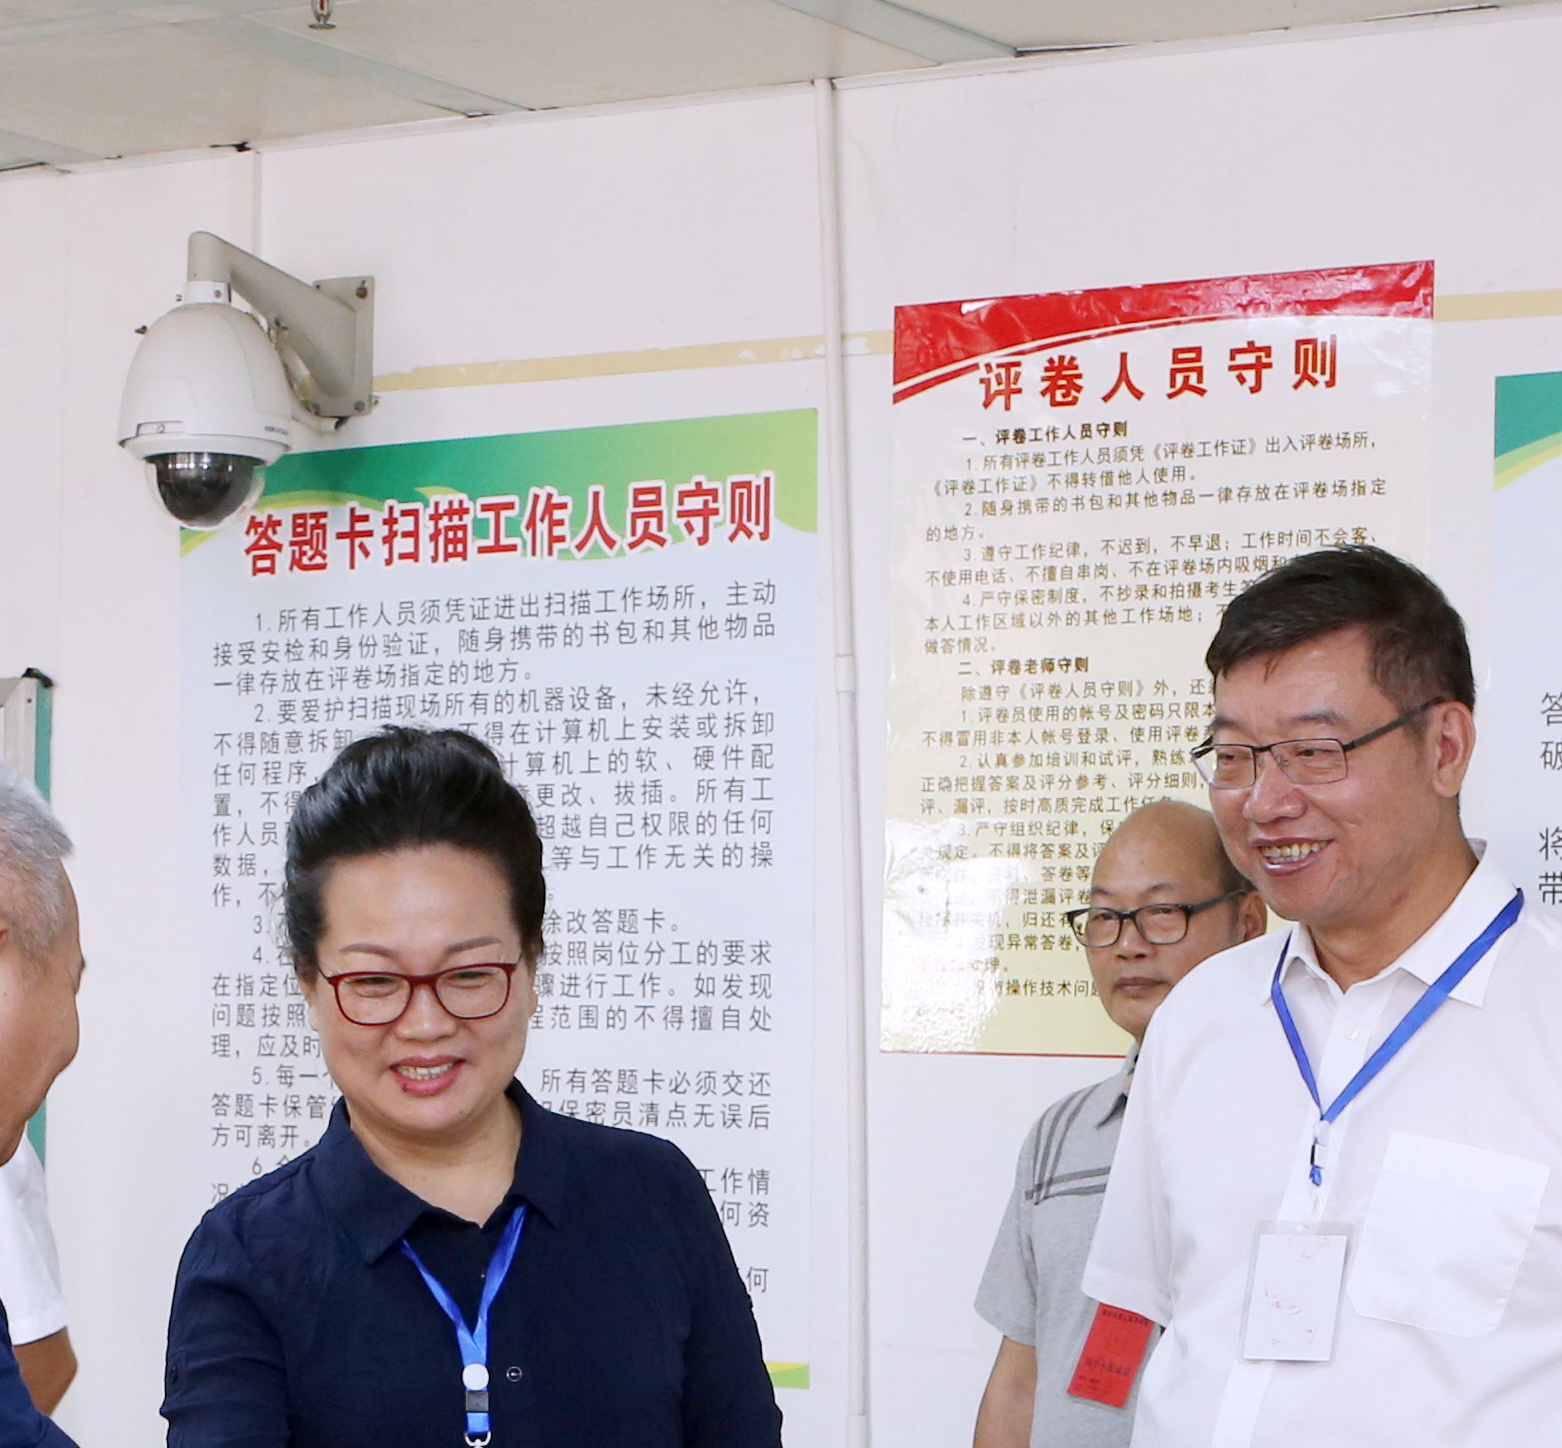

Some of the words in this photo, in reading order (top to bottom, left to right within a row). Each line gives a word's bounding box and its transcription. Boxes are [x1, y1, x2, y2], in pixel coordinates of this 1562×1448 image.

[979, 333, 1340, 412] 评卷人员守则
[963, 420, 1128, 447] 一、评卷工作人员守则
[243, 475, 775, 578] 答题卡扫描工作人员守则
[926, 524, 985, 543] 的地方。
[255, 579, 777, 633] 1.所有工作人员须凭证进出扫描工作场所，主动
[212, 612, 776, 667] 接受安检和身份验证，随身携带的书包和其他物品
[924, 637, 997, 656] 做答情况。
[213, 657, 533, 697] 一律存放在评卷场指定的地方。
[958, 656, 1089, 676] 二、评卷老师守则
[254, 678, 761, 724] 2.要爱护扫描现场所有的机器设备，未经允许，
[959, 748, 1194, 770] 2.认真参加培训和试评，熟练
[211, 1123, 310, 1149] 方可离开。
